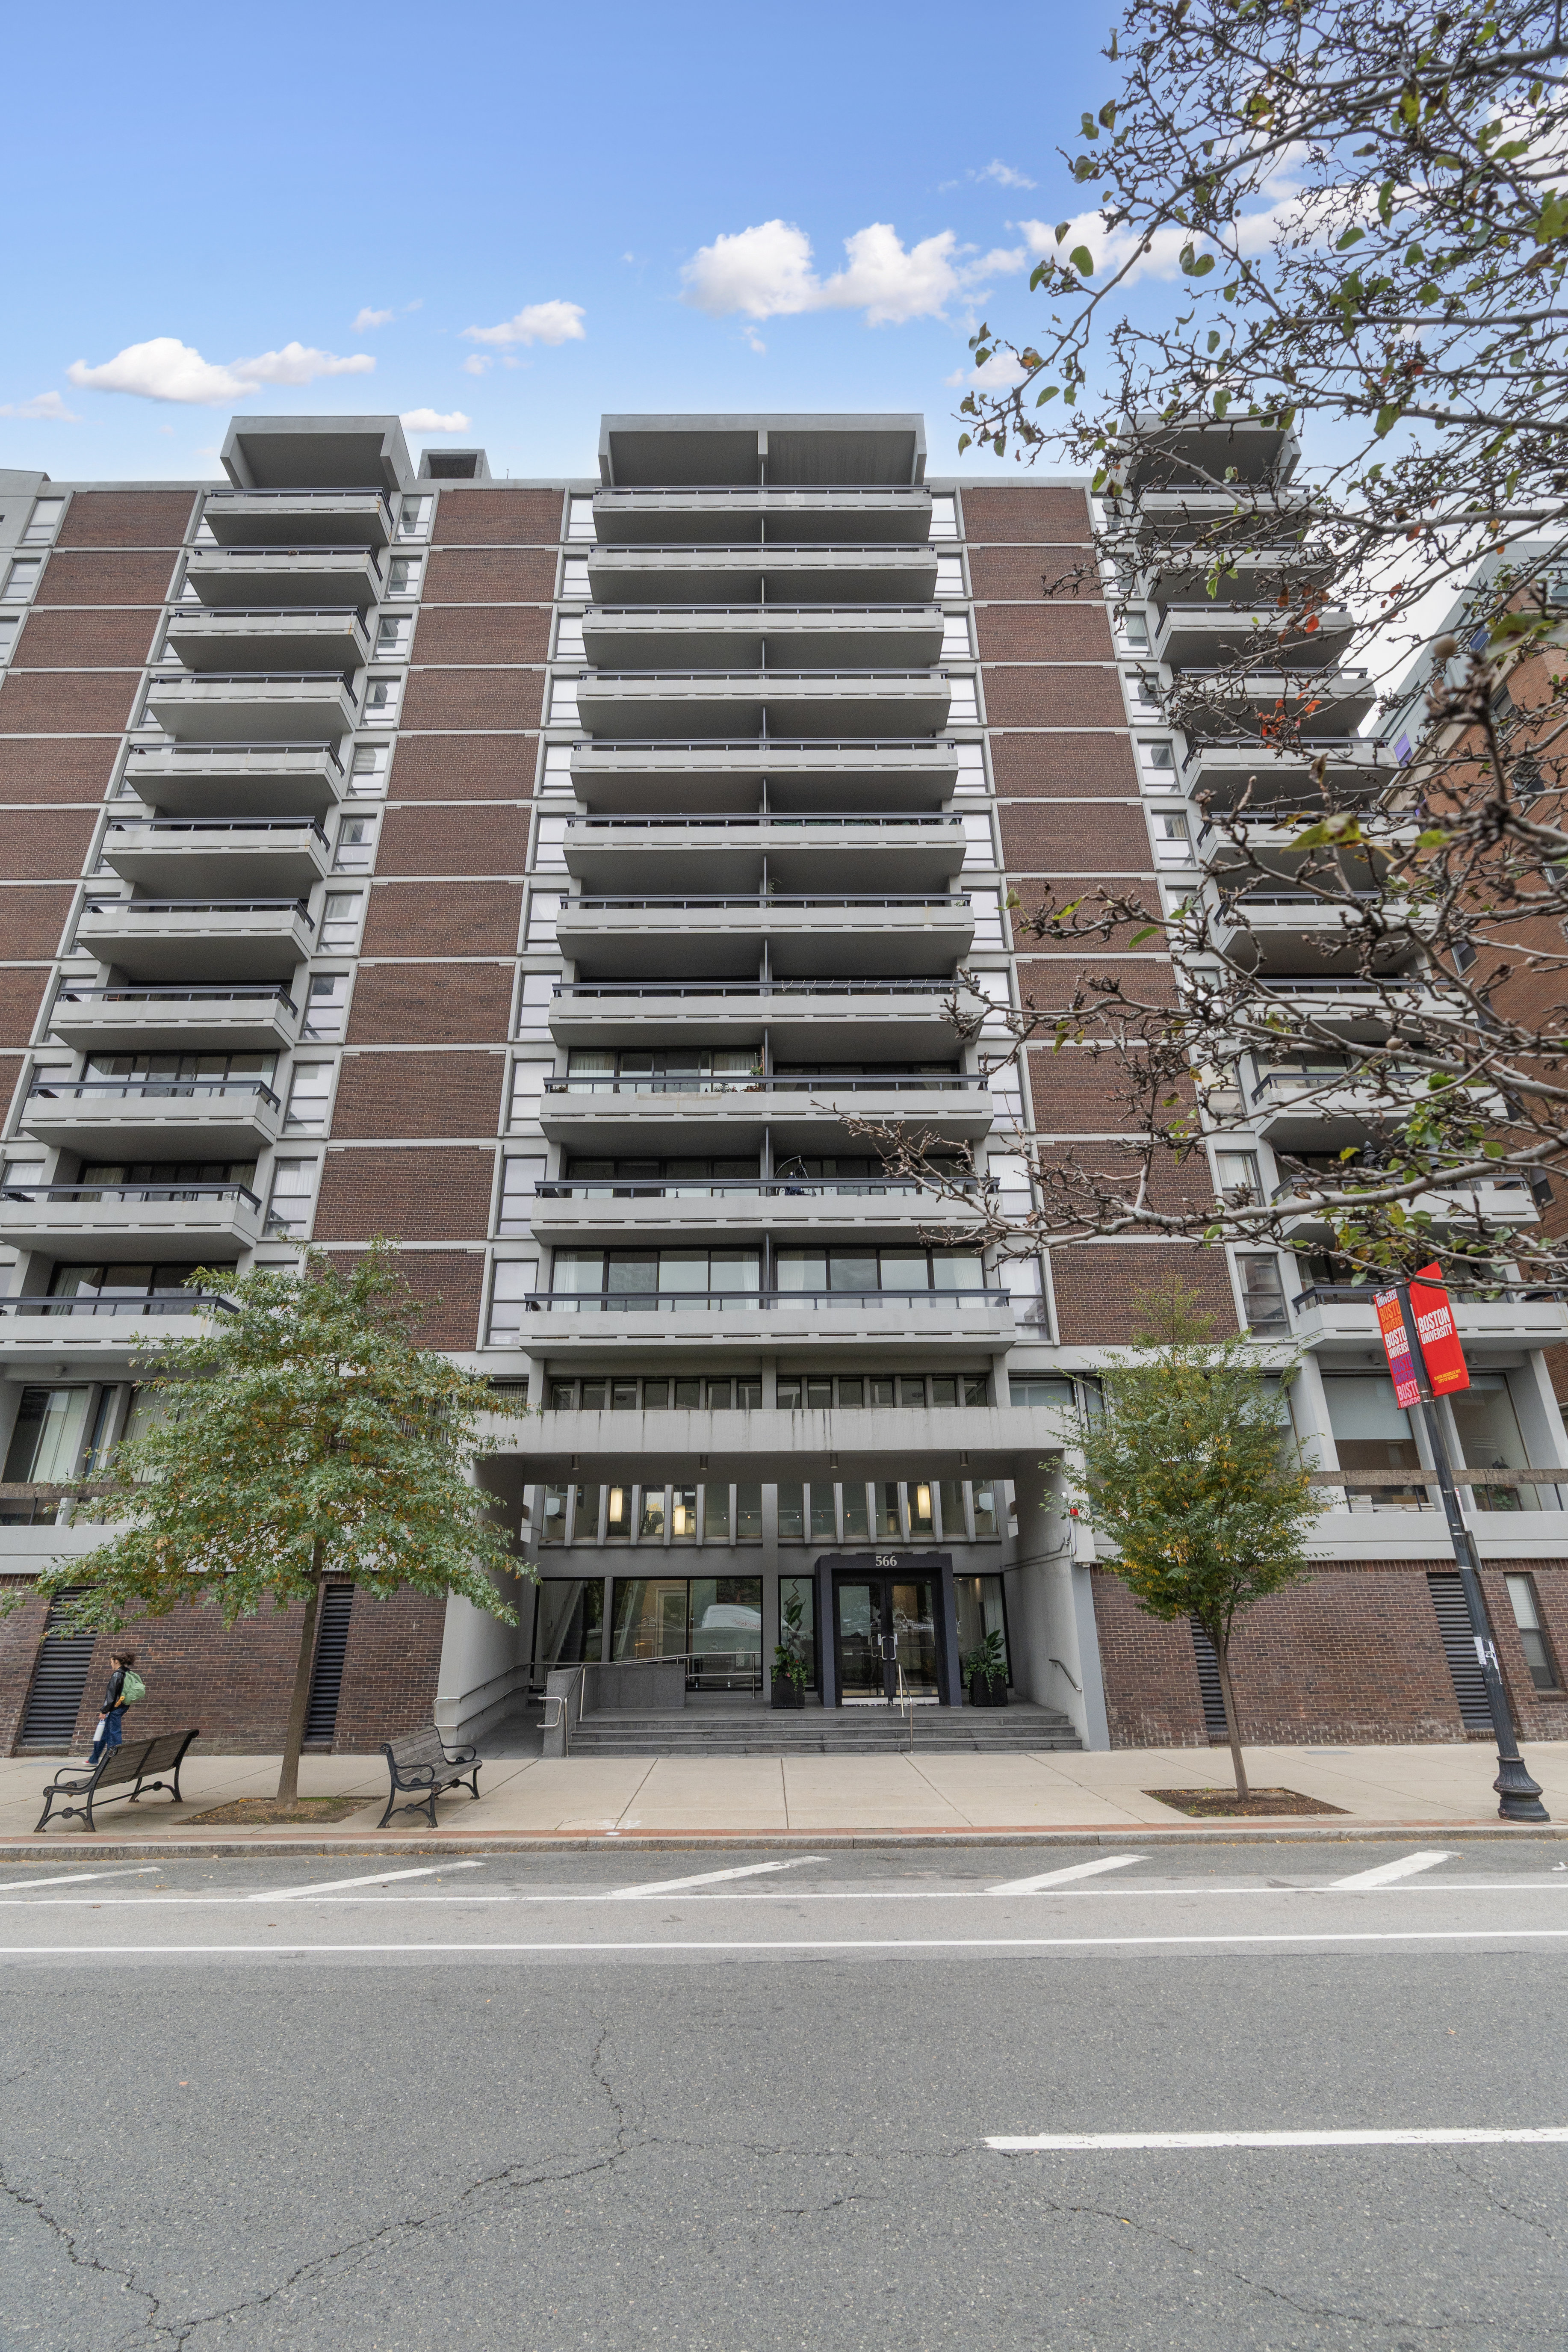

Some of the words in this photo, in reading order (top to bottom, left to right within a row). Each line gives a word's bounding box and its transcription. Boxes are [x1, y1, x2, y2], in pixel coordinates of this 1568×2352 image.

[1417, 1306, 1450, 1333] BOSTON
[1420, 1322, 1453, 1344] UNIVERSITY
[875, 1555, 897, 1566] 566
